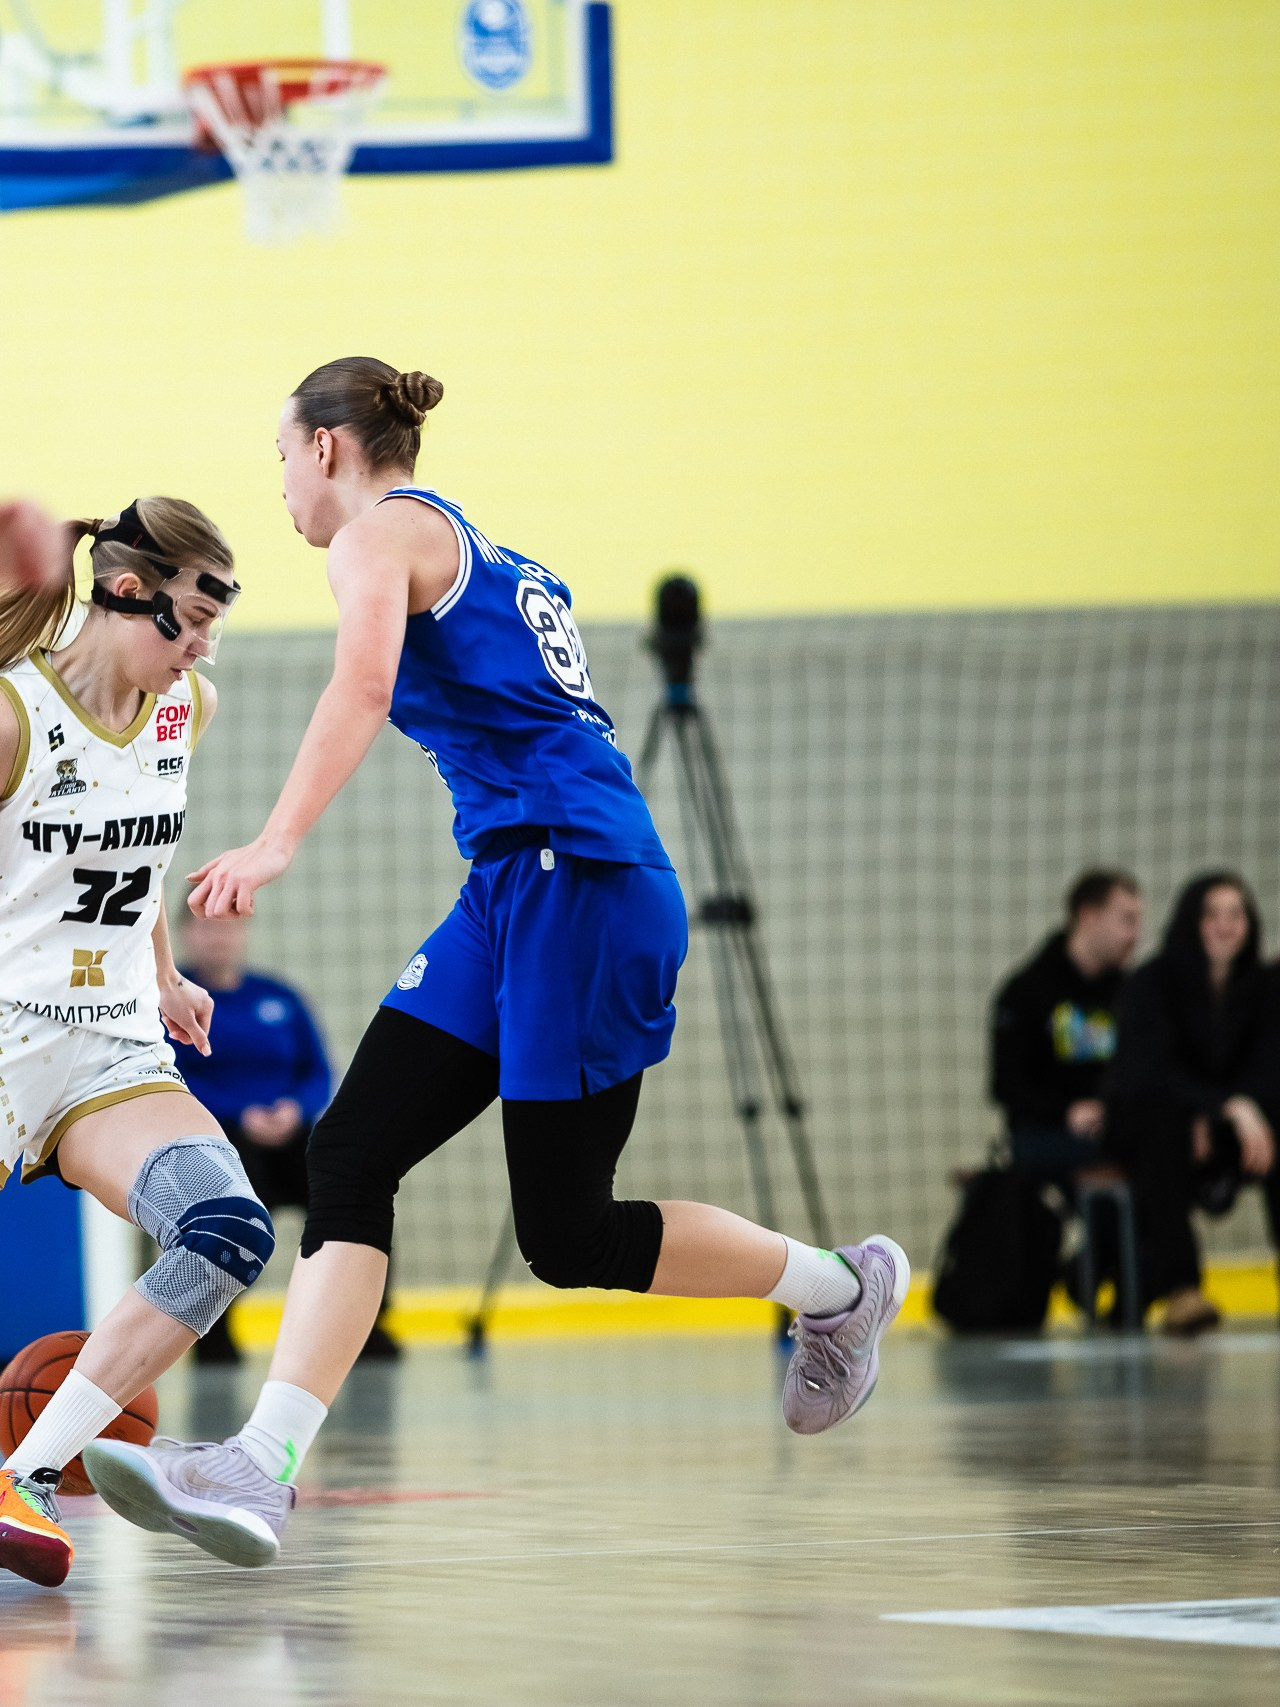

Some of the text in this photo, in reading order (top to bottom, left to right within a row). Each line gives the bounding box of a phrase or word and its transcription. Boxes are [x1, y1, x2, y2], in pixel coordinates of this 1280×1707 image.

[156, 703, 191, 724] FON
[157, 722, 186, 742] BET
[22, 809, 186, 855] ЧГУ-АТЛАН
[58, 865, 151, 928] 32
